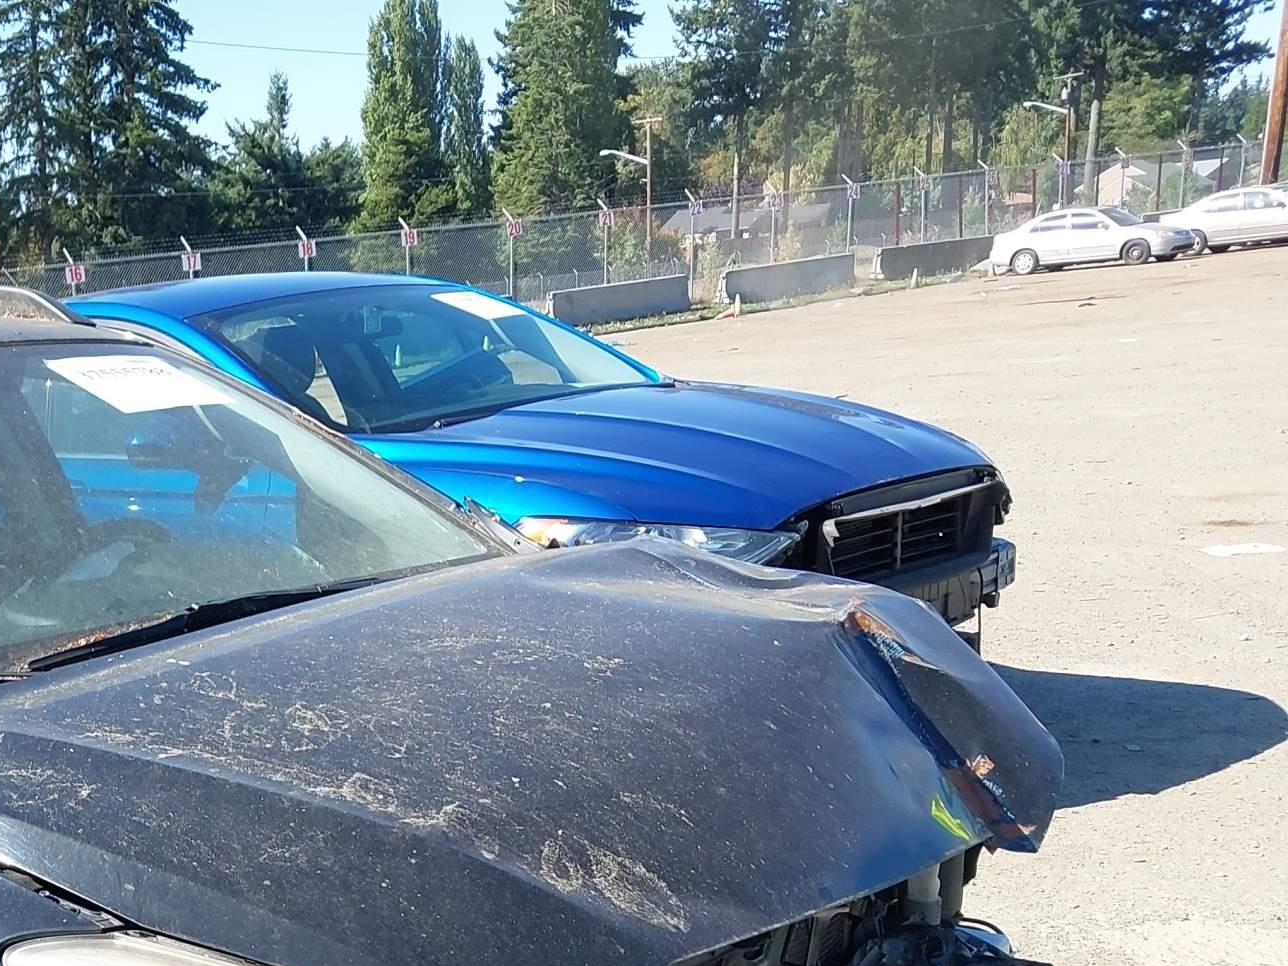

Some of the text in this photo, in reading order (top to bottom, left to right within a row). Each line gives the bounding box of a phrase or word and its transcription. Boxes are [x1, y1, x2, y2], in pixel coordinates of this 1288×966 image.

[848, 184, 857, 199] 24
[771, 192, 783, 207] 23
[691, 202, 702, 216] 22
[602, 210, 612, 226] 21
[508, 220, 521, 237] 20
[404, 230, 415, 245] 19
[301, 241, 313, 256] 18
[187, 255, 197, 271] 17
[69, 267, 83, 282] 16
